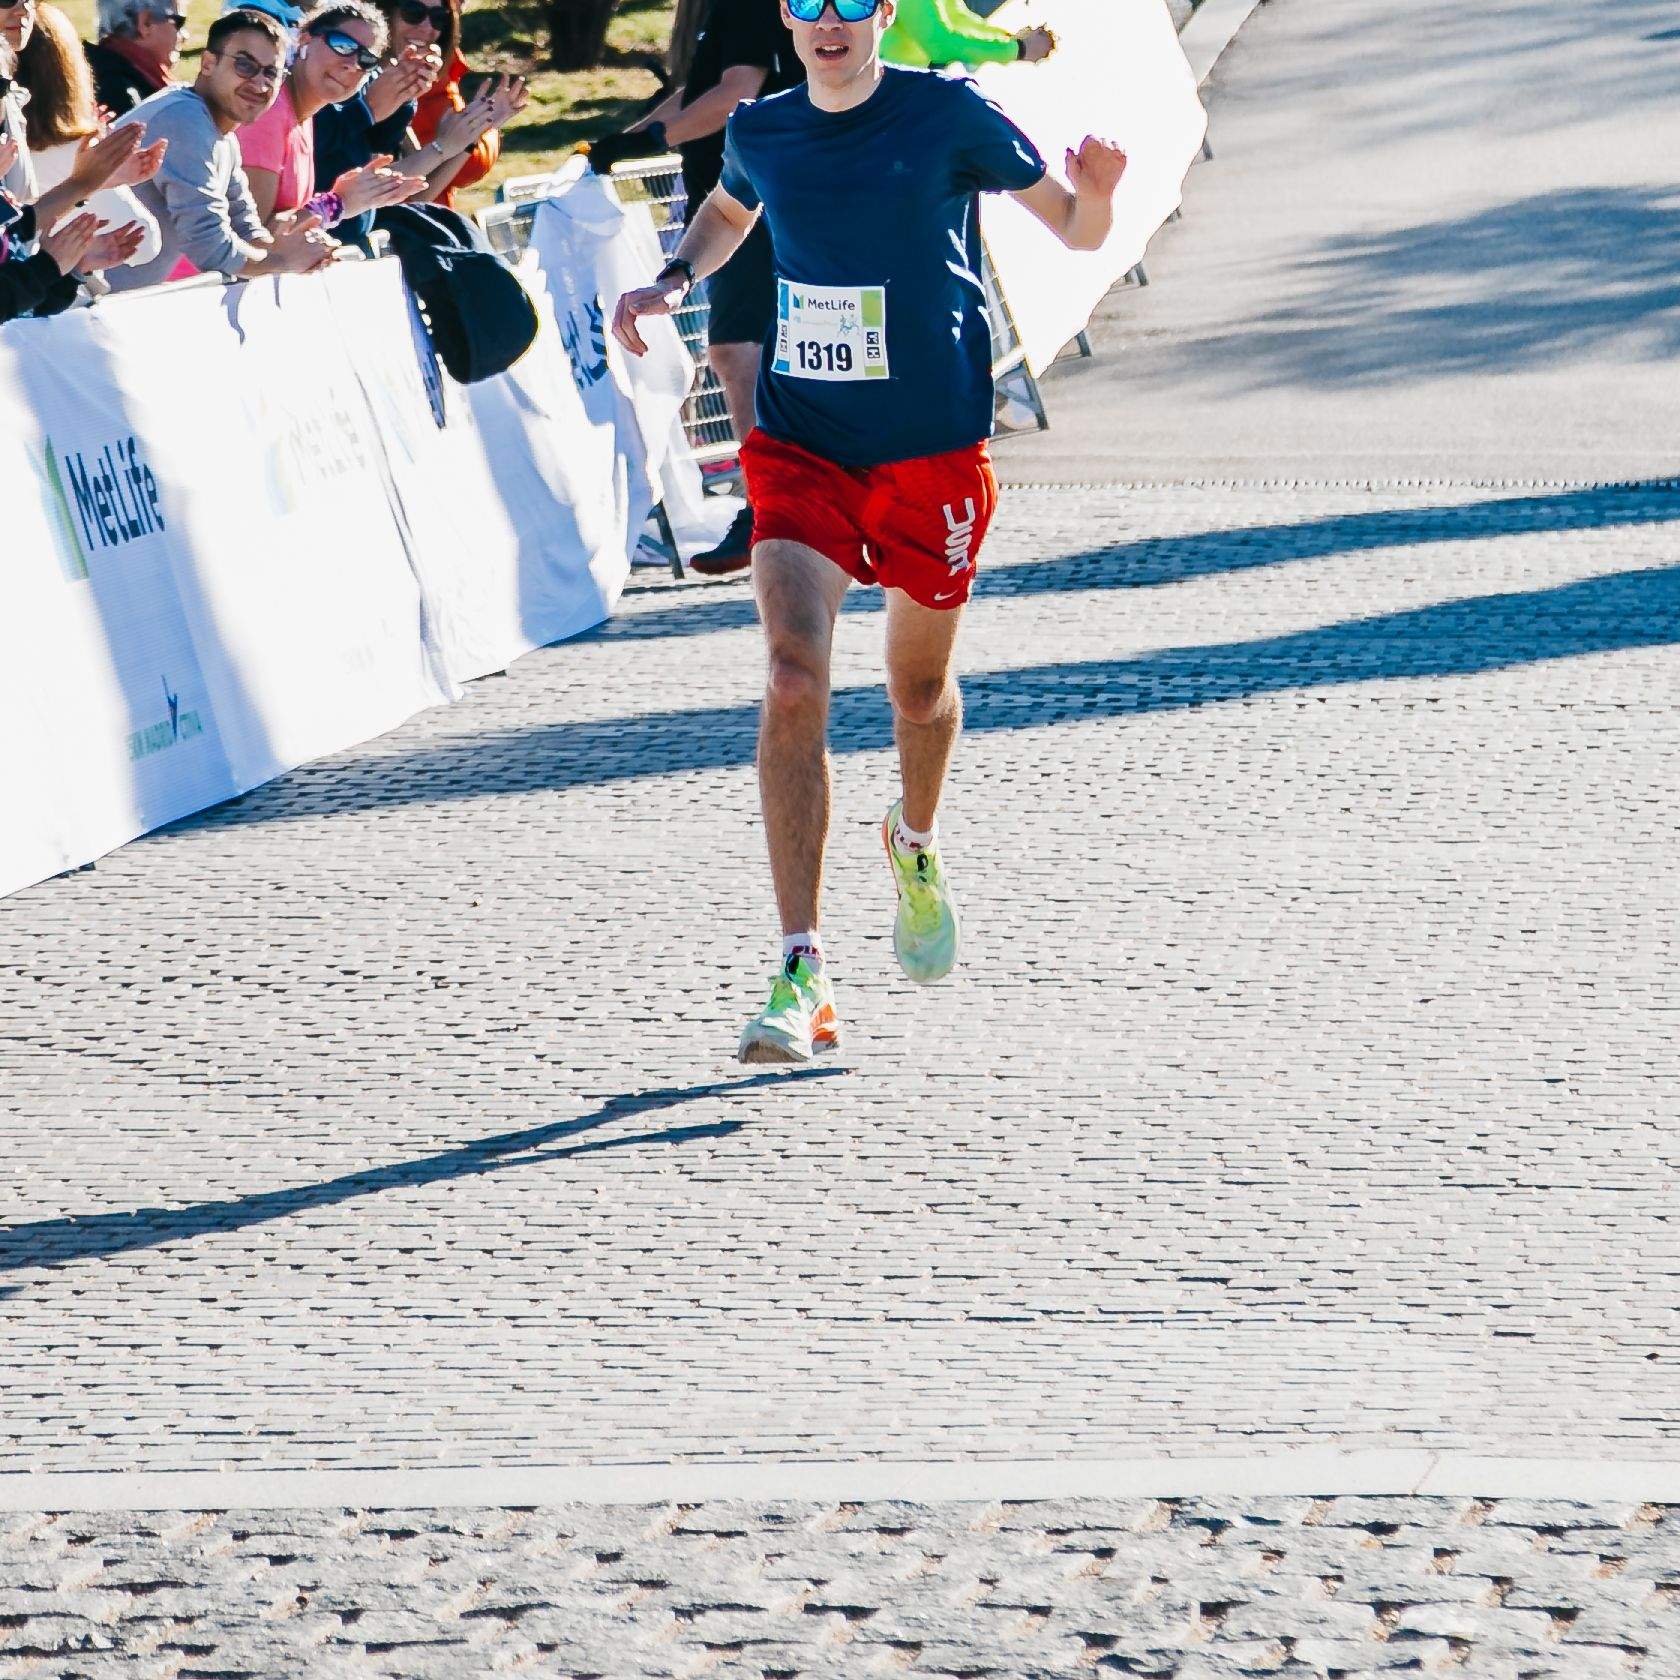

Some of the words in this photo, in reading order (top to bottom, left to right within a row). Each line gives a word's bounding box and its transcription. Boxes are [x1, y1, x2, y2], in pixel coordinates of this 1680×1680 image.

[807, 298, 856, 311] MetLife
[795, 340, 853, 372] 1319
[64, 436, 166, 551] MetLife
